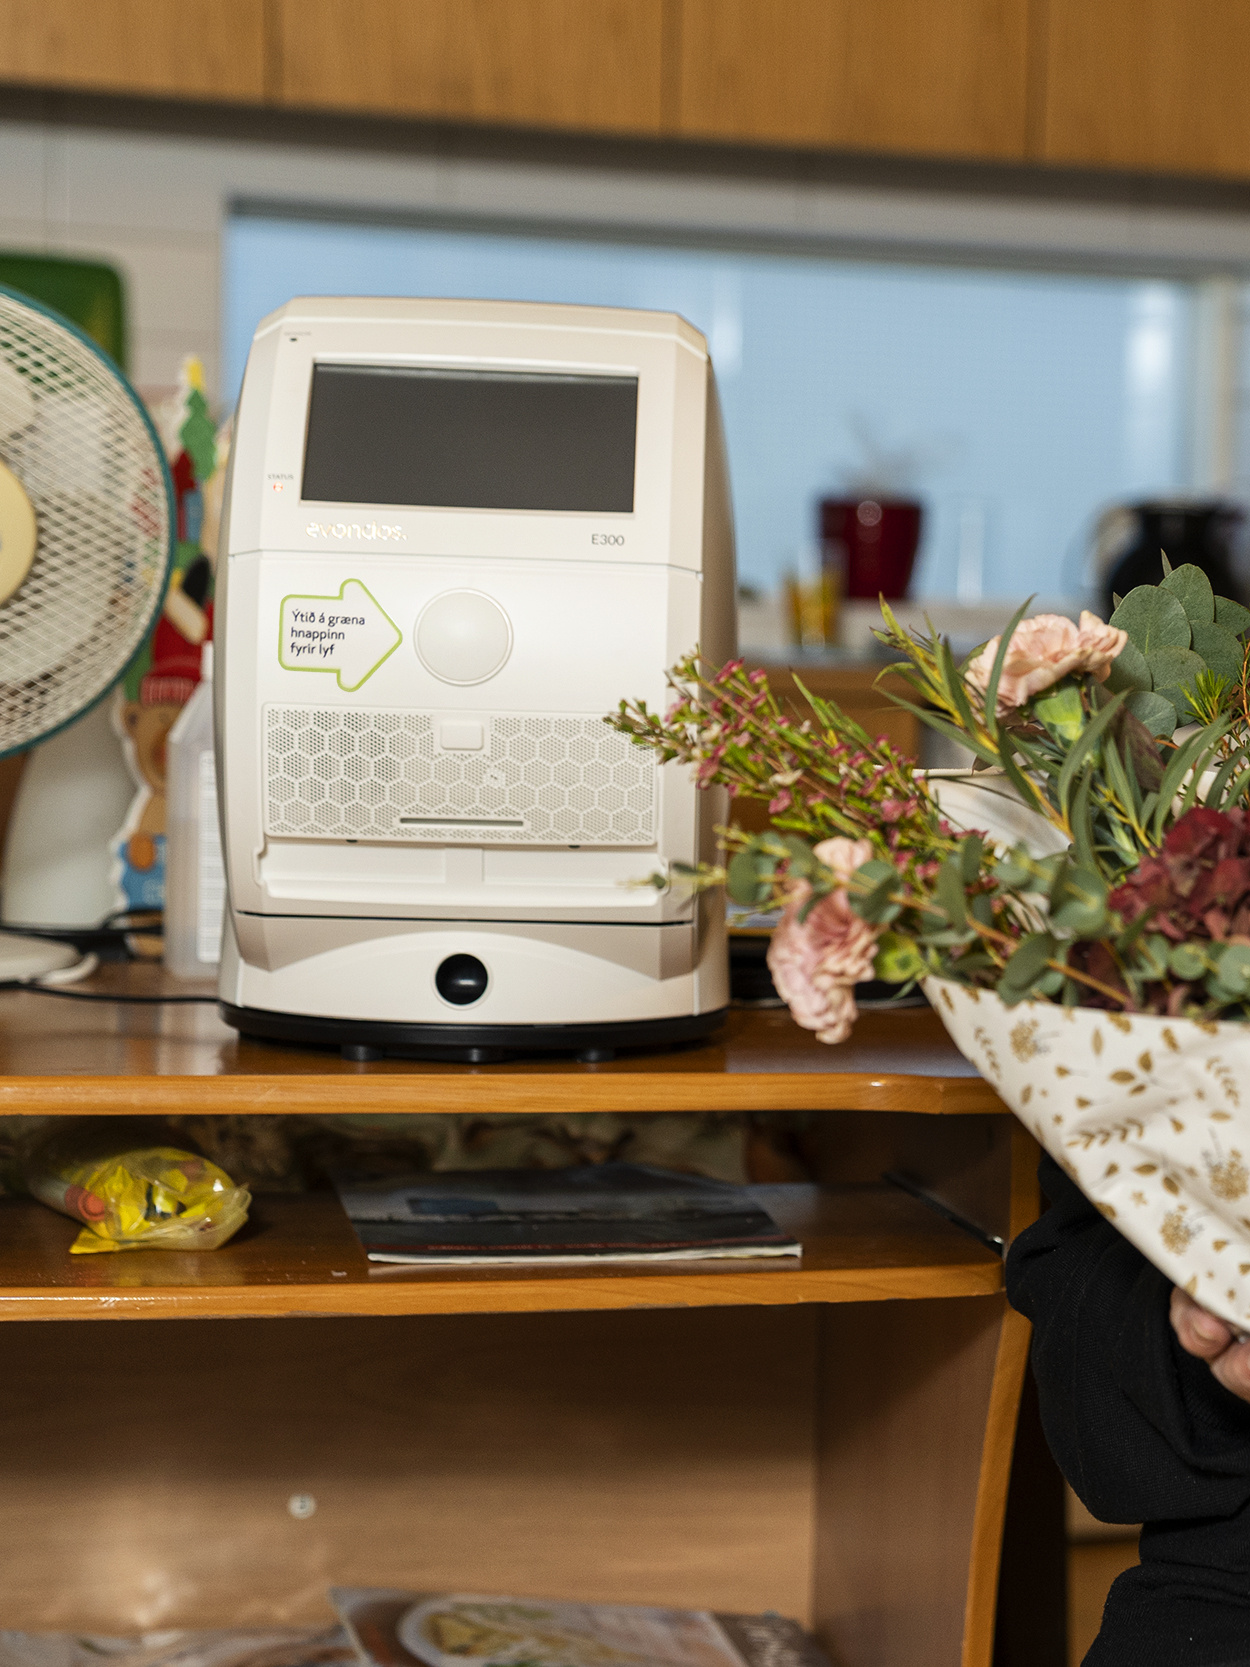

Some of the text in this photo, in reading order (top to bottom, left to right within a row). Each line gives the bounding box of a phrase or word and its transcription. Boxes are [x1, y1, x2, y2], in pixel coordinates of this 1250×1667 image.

[591, 533, 625, 546] E300
[292, 609, 366, 627] Ýtið á græna
[291, 627, 345, 642] hnappinn
[290, 642, 335, 658] fyrir lyf
